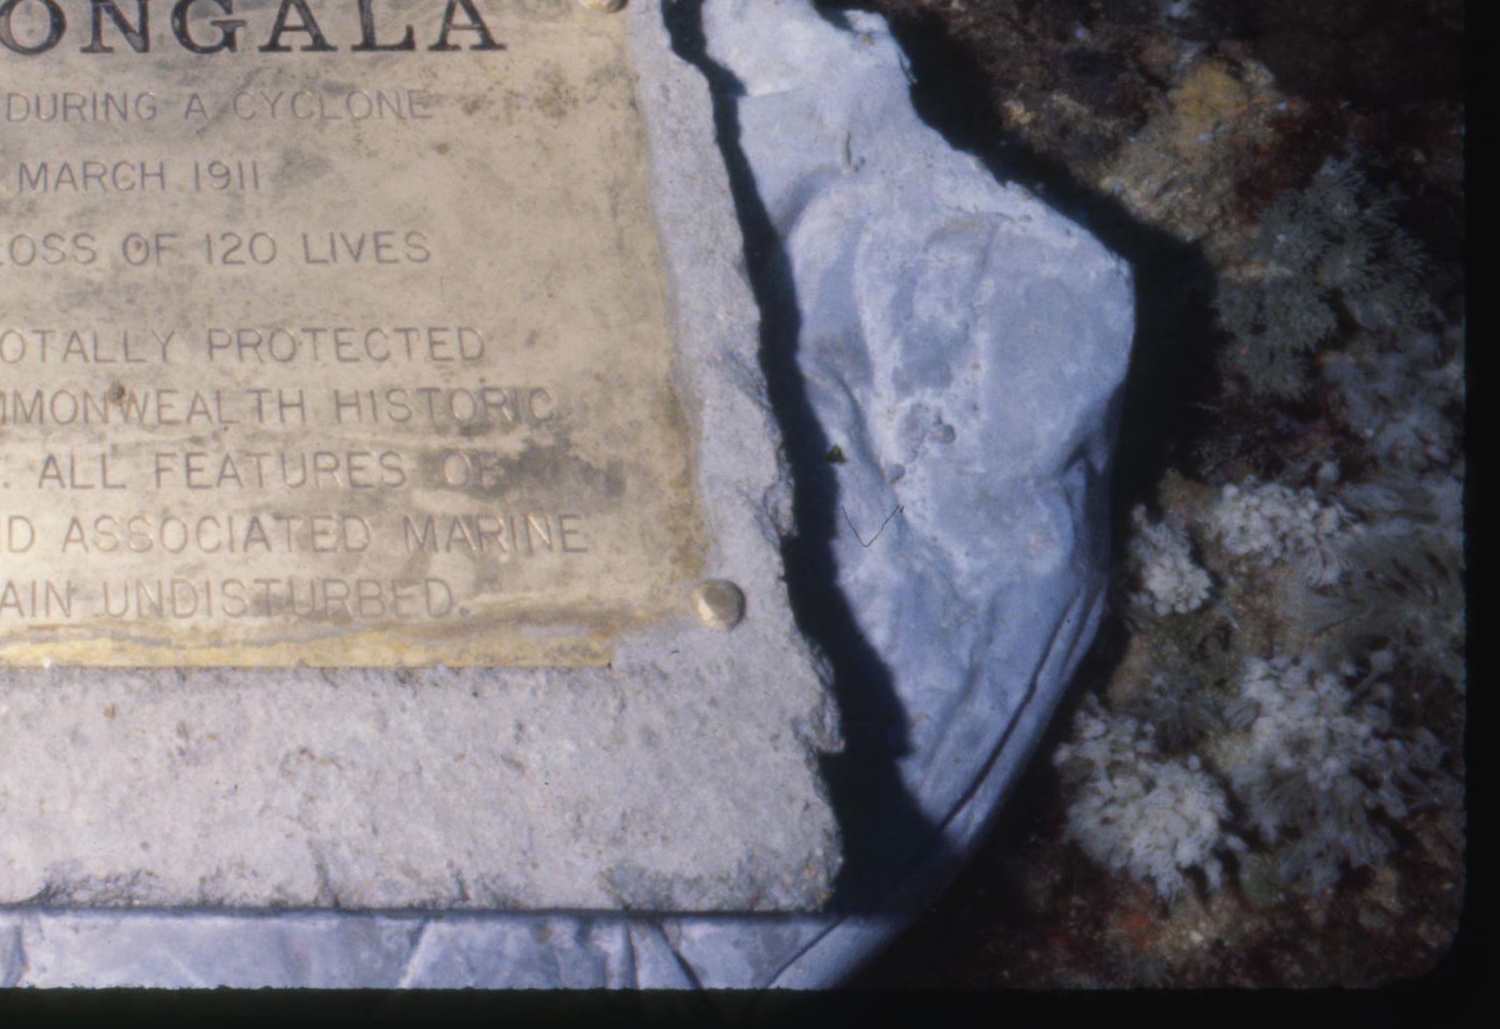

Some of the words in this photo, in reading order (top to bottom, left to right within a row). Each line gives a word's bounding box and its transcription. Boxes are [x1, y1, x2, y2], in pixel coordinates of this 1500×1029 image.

[6, 91, 158, 123] DURING
[183, 91, 205, 121] A
[232, 89, 434, 121] CYCLONE
[18, 160, 166, 192] MARCH
[193, 160, 260, 191] 1911
[122, 233, 177, 266] OF
[204, 232, 277, 265] 120
[302, 231, 431, 264] LIVES
[206, 327, 486, 363] PROTECTED
[334, 386, 555, 424] HISTORIC
[38, 452, 127, 490] ALL
[154, 451, 407, 490] FEATURES
[61, 515, 371, 554] ASSOCIATED
[403, 513, 589, 553] MARINE
